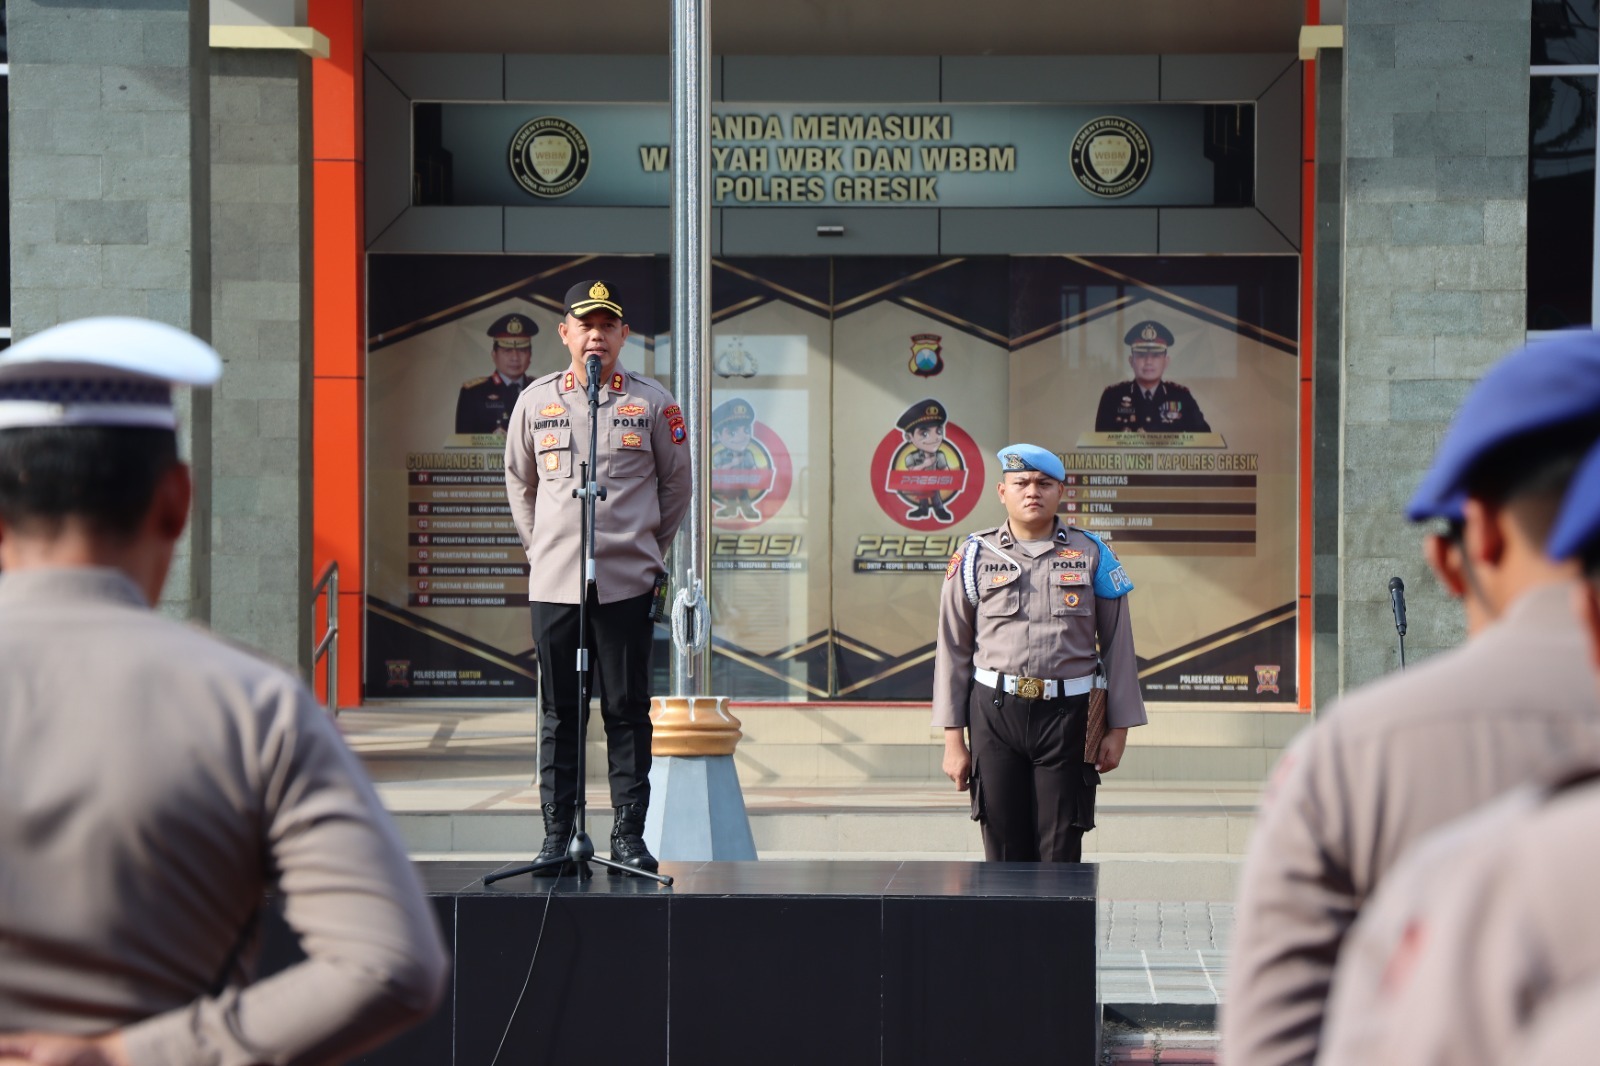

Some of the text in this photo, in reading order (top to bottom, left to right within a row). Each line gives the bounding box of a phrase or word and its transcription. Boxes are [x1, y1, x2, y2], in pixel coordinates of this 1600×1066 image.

[712, 116, 951, 140] ANDA MEMASUKI
[535, 151, 567, 160] WBBM
[778, 147, 843, 171] WBK
[853, 147, 911, 171] DAN
[921, 147, 1015, 171] WBBM
[1094, 151, 1126, 160] WBBM
[716, 177, 938, 202] POLRES GRESIK
[613, 418, 650, 428] POLRI
[406, 453, 484, 470] COMMANDER
[1125, 454, 1154, 470] WISH
[1157, 454, 1214, 470] KAPOLRES
[1217, 454, 1259, 471] GRESIK
[901, 475, 954, 486] PRESISI
[1053, 561, 1087, 569] POLRI
